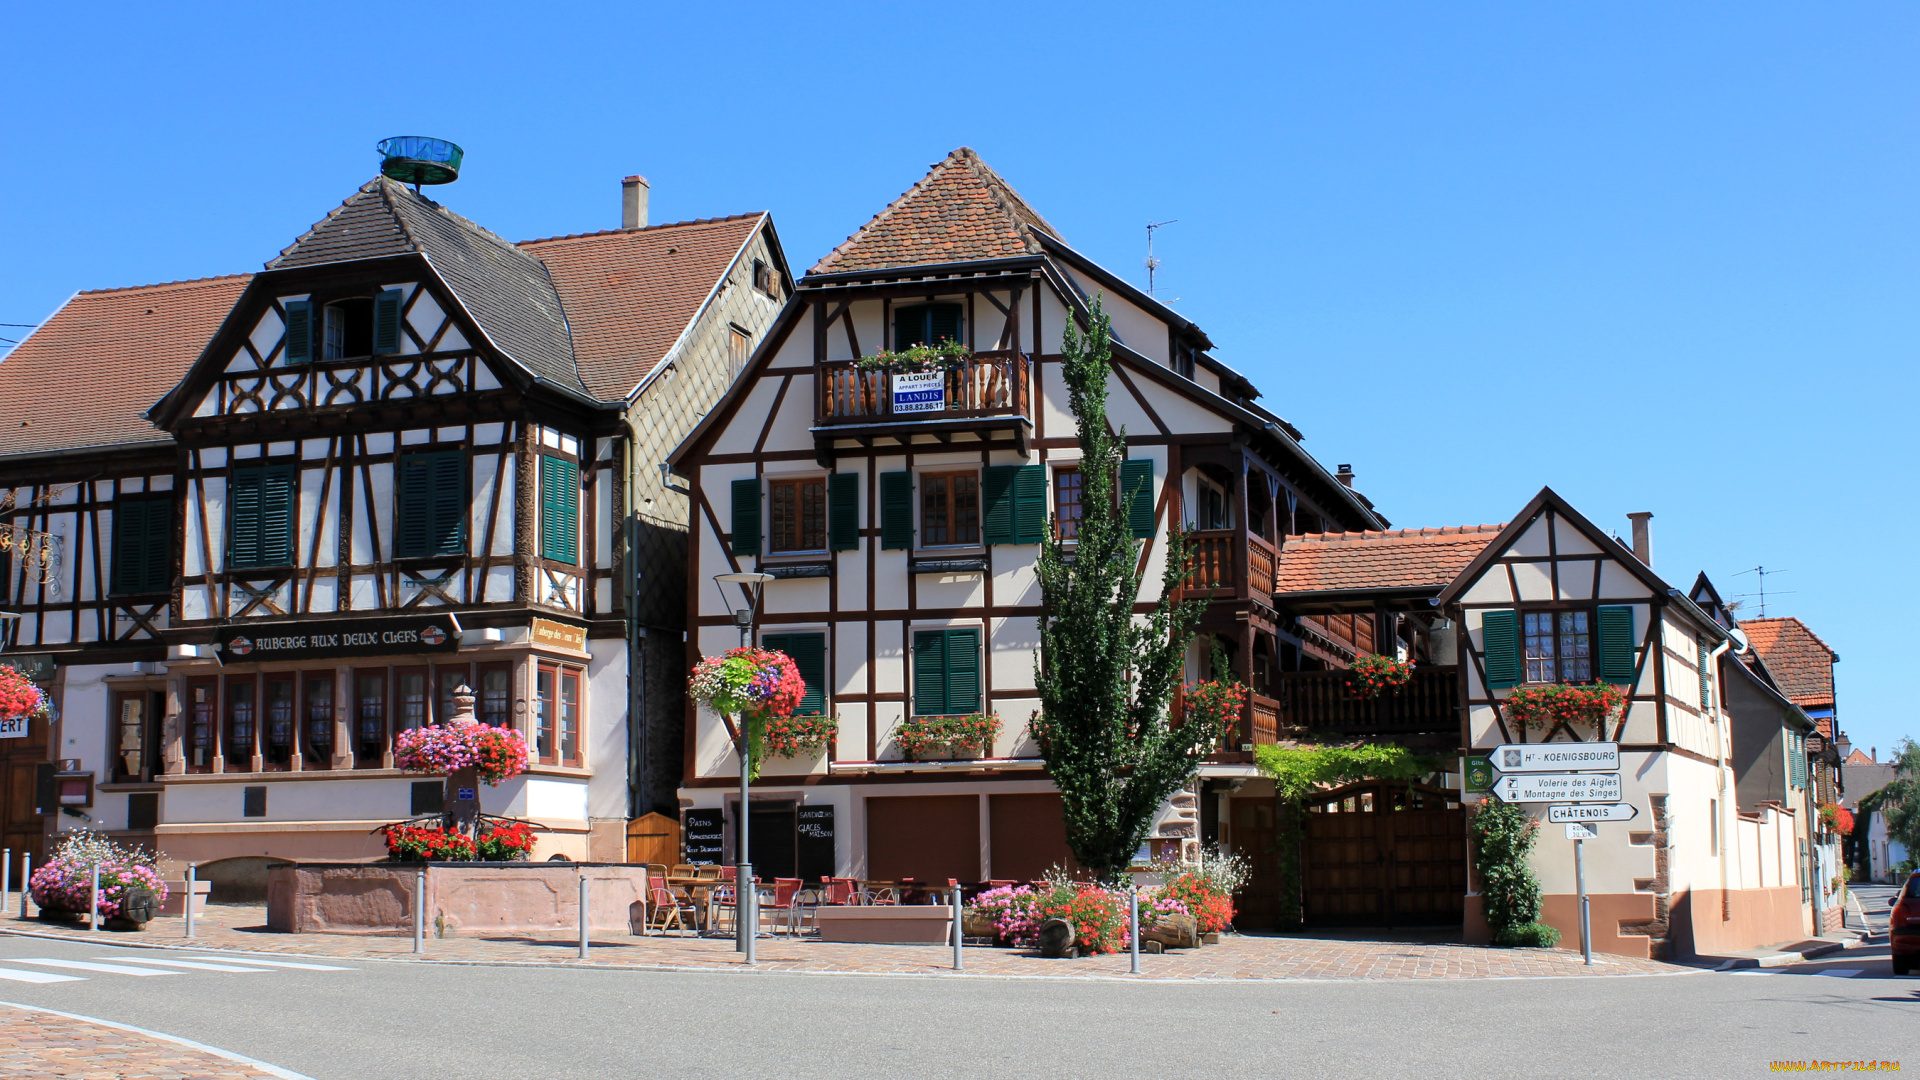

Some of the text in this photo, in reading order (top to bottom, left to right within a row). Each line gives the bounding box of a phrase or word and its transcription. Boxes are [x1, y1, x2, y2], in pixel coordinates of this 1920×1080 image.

[899, 392, 939, 402] LANDIS
[255, 636, 307, 650] AUBERGE
[310, 634, 338, 648] AUX
[342, 632, 379, 646] DEUX
[382, 630, 418, 644] CLEFS
[1543, 751, 1615, 762] KOENIGSBOURG
[1538, 777, 1617, 788] Volerie des Aigles
[1523, 787, 1618, 800] Montagne des Singes
[1553, 808, 1609, 819] CHÂTENOIS
[688, 817, 712, 827] PAINS
[797, 823, 821, 833] GLACES
